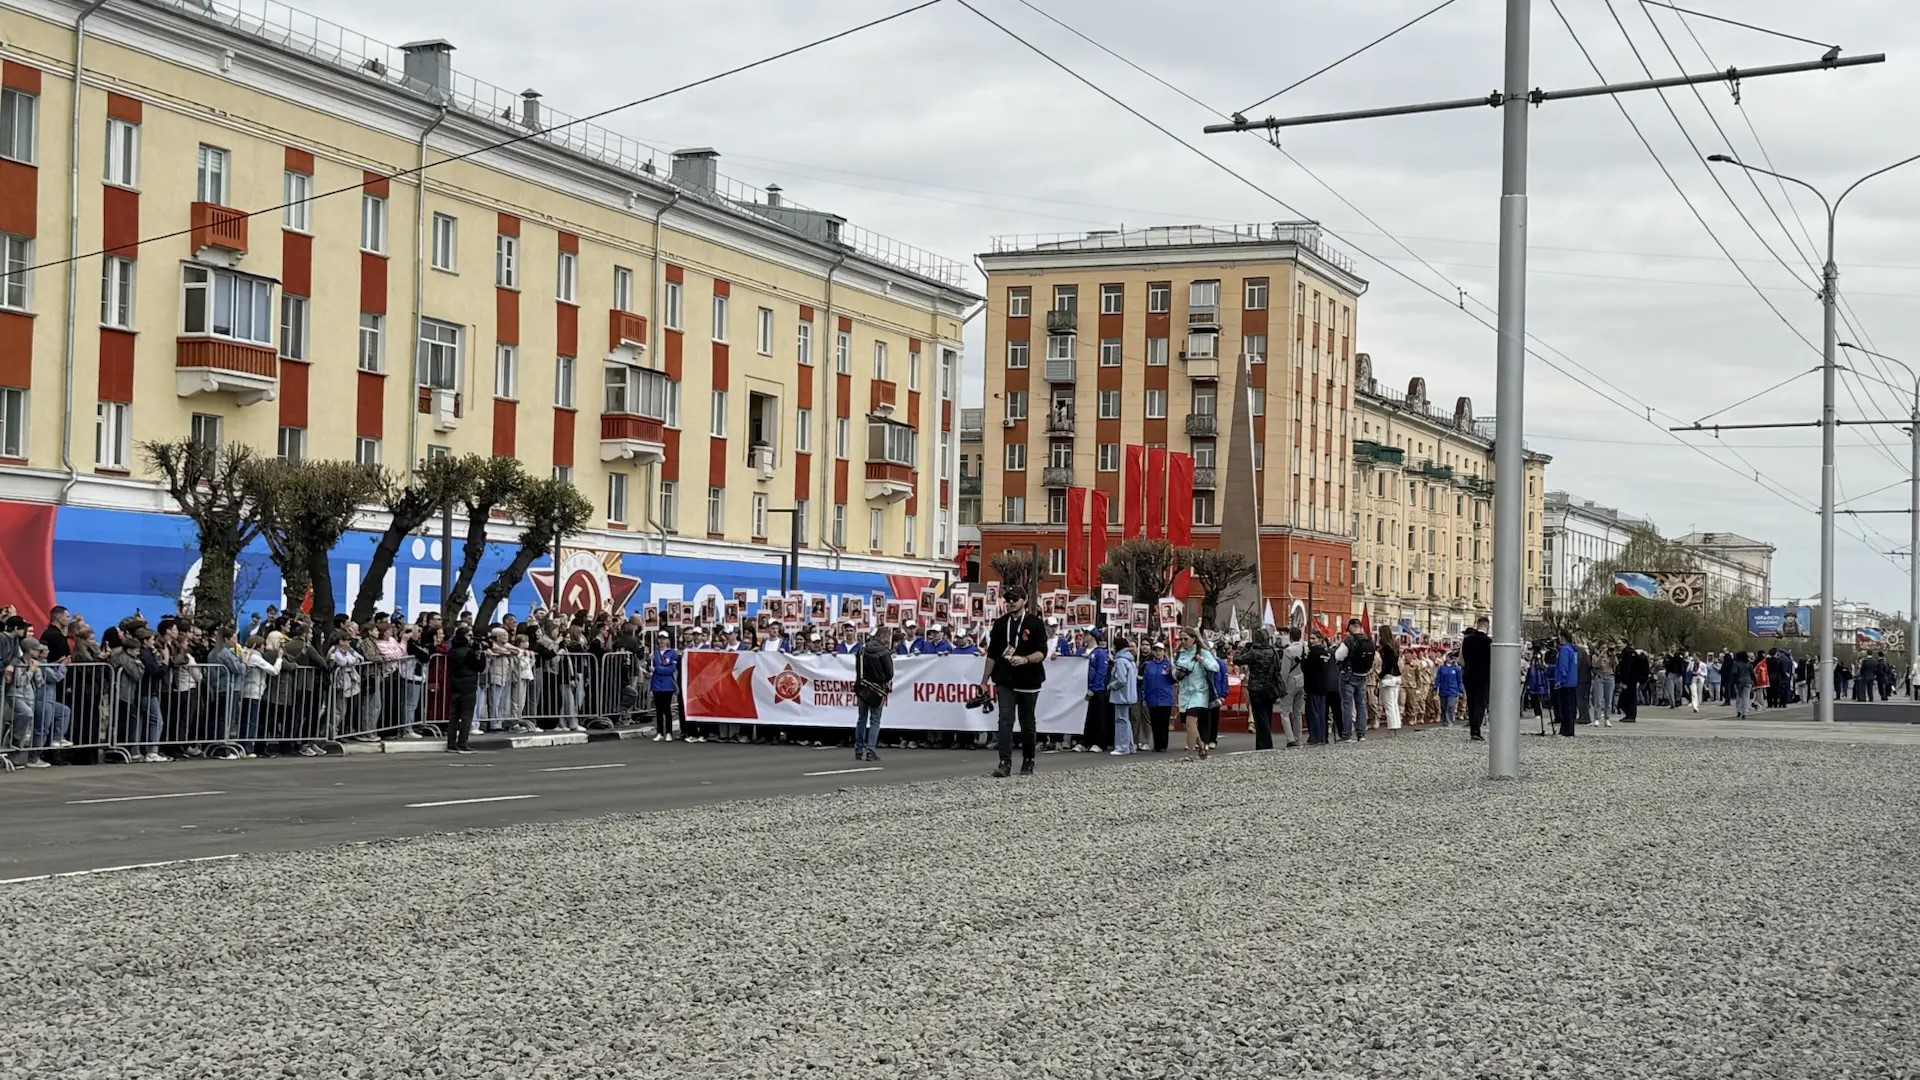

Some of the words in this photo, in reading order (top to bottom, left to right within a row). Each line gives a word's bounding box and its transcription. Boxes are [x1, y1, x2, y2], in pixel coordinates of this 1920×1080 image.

[814, 680, 893, 693] БЕССМЕ
[914, 682, 998, 703] КРАСНО
[814, 693, 842, 706] ПОЛК
